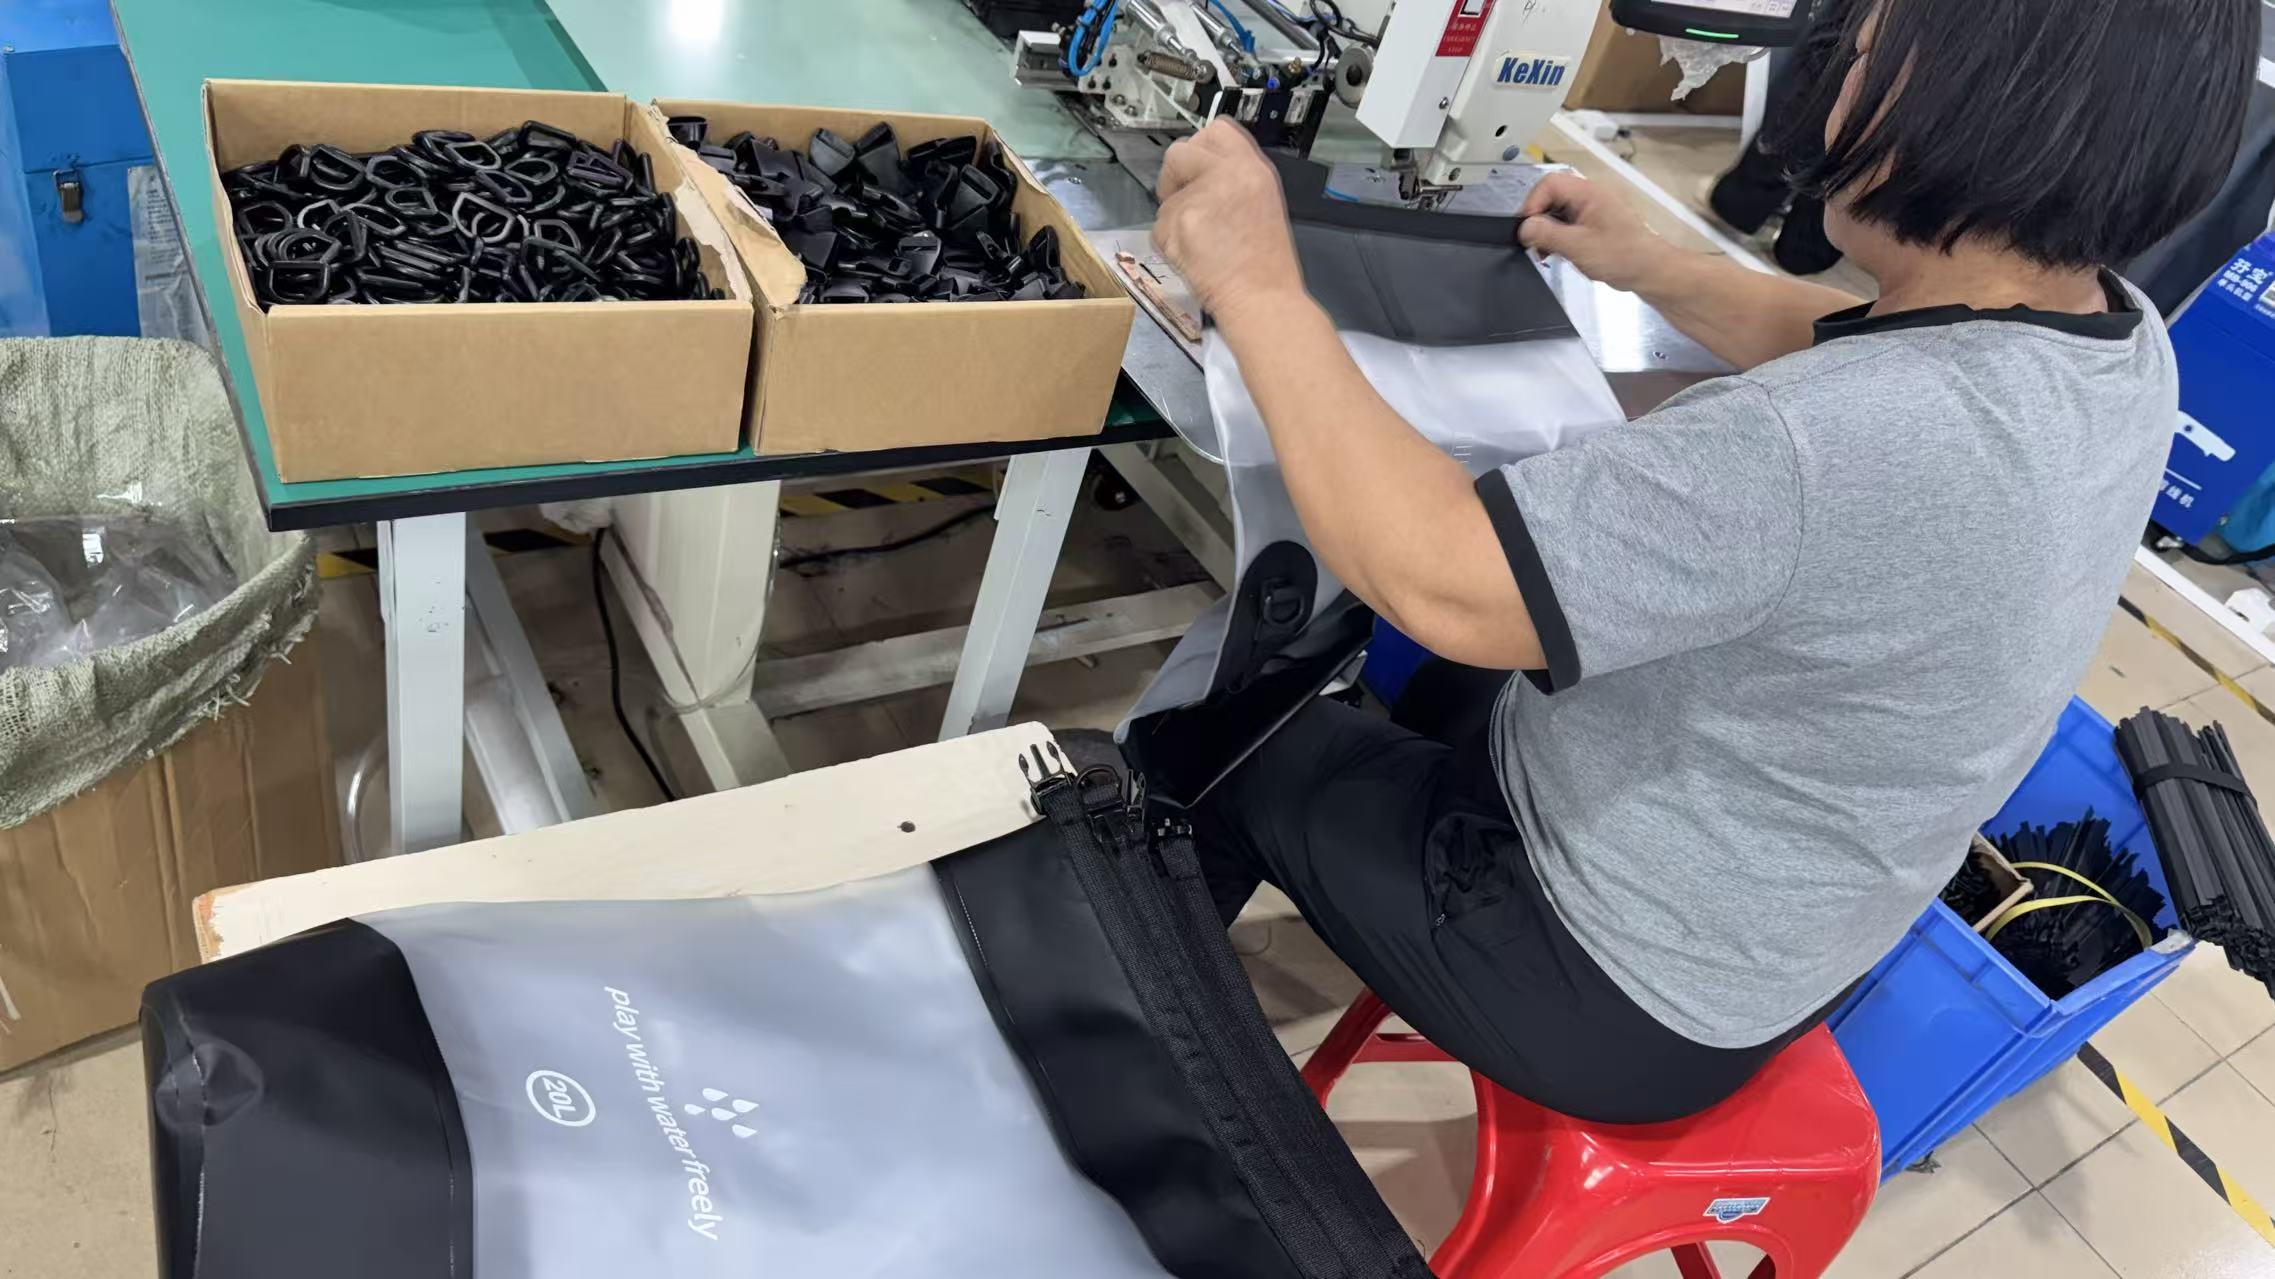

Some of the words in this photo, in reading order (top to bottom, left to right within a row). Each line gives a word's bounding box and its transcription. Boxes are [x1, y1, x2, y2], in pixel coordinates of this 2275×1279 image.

[1497, 57, 1565, 86] KeXin
[542, 1077, 576, 1118] 20L
[604, 986, 640, 1041] play
[626, 1043, 665, 1093] with
[647, 1096, 696, 1160] water
[681, 1157, 723, 1240] freely
